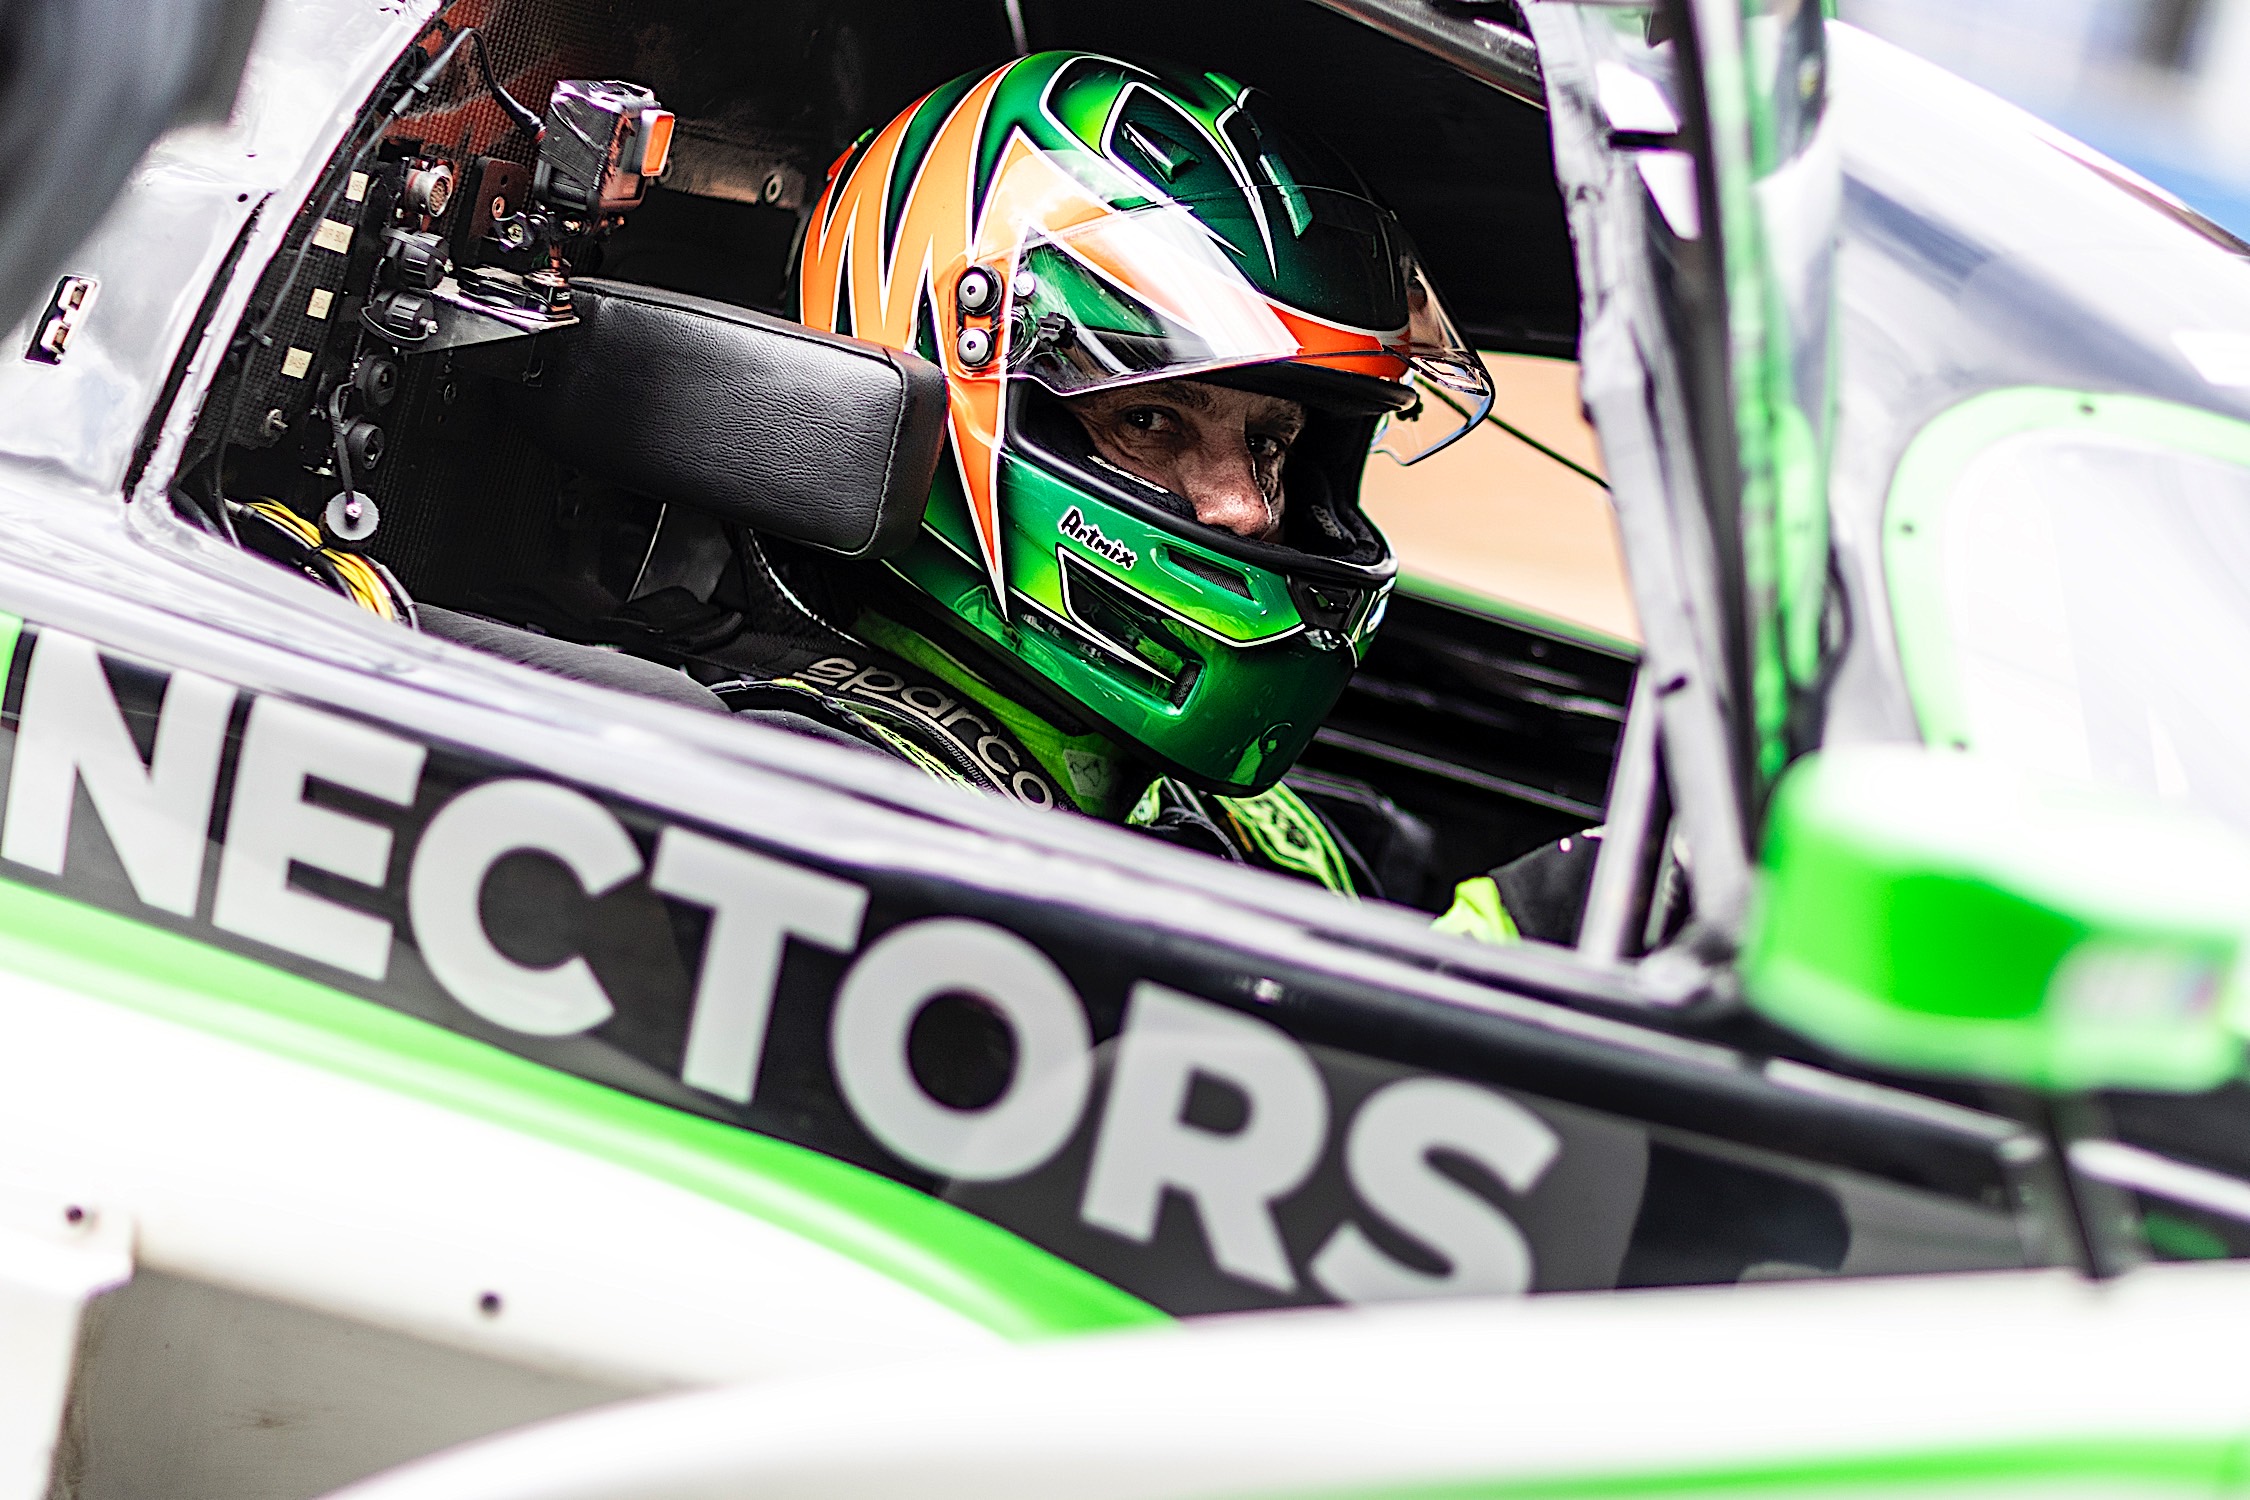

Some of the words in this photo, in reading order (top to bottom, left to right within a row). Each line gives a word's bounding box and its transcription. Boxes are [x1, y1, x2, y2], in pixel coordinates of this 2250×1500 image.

[1058, 506, 1137, 570] Artmix
[804, 657, 1054, 812] sparco
[1, 627, 1560, 1307] NECTORS
